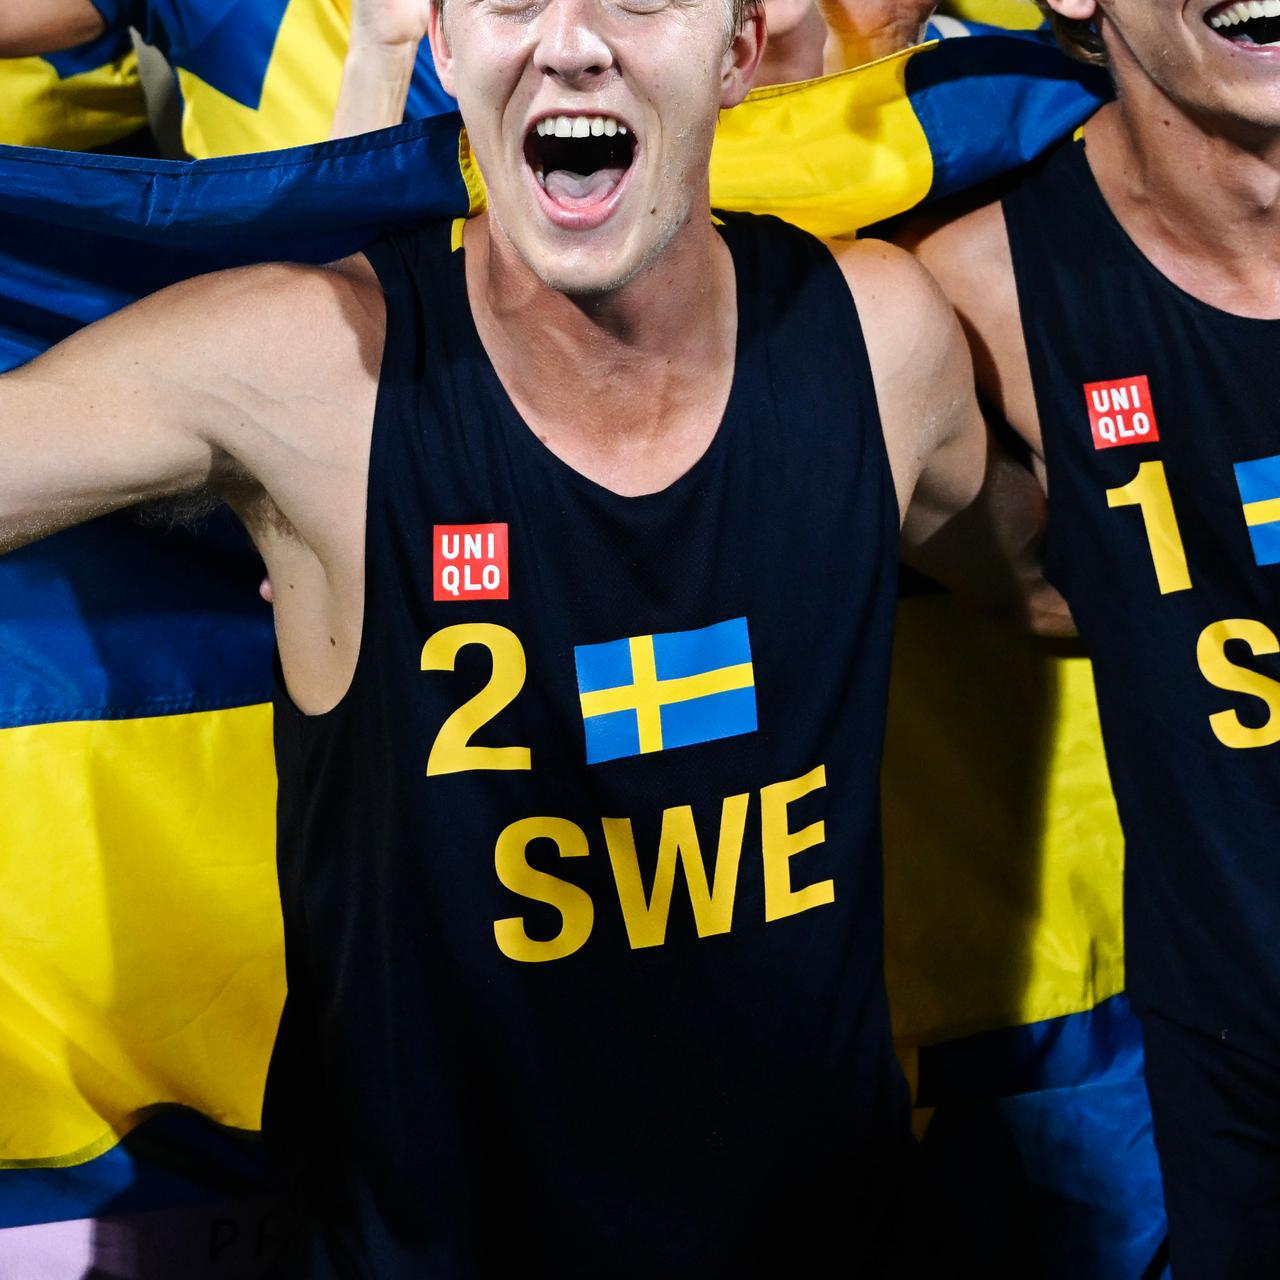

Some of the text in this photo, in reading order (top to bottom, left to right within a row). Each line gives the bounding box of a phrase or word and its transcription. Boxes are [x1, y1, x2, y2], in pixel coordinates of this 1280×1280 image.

[1091, 385, 1141, 413] UNI
[1097, 411, 1150, 443] QLO
[1106, 460, 1193, 595] 1
[441, 533, 495, 560] UNI
[441, 564, 501, 596] QLO
[420, 622, 532, 777] 2
[493, 764, 835, 963] SWE
